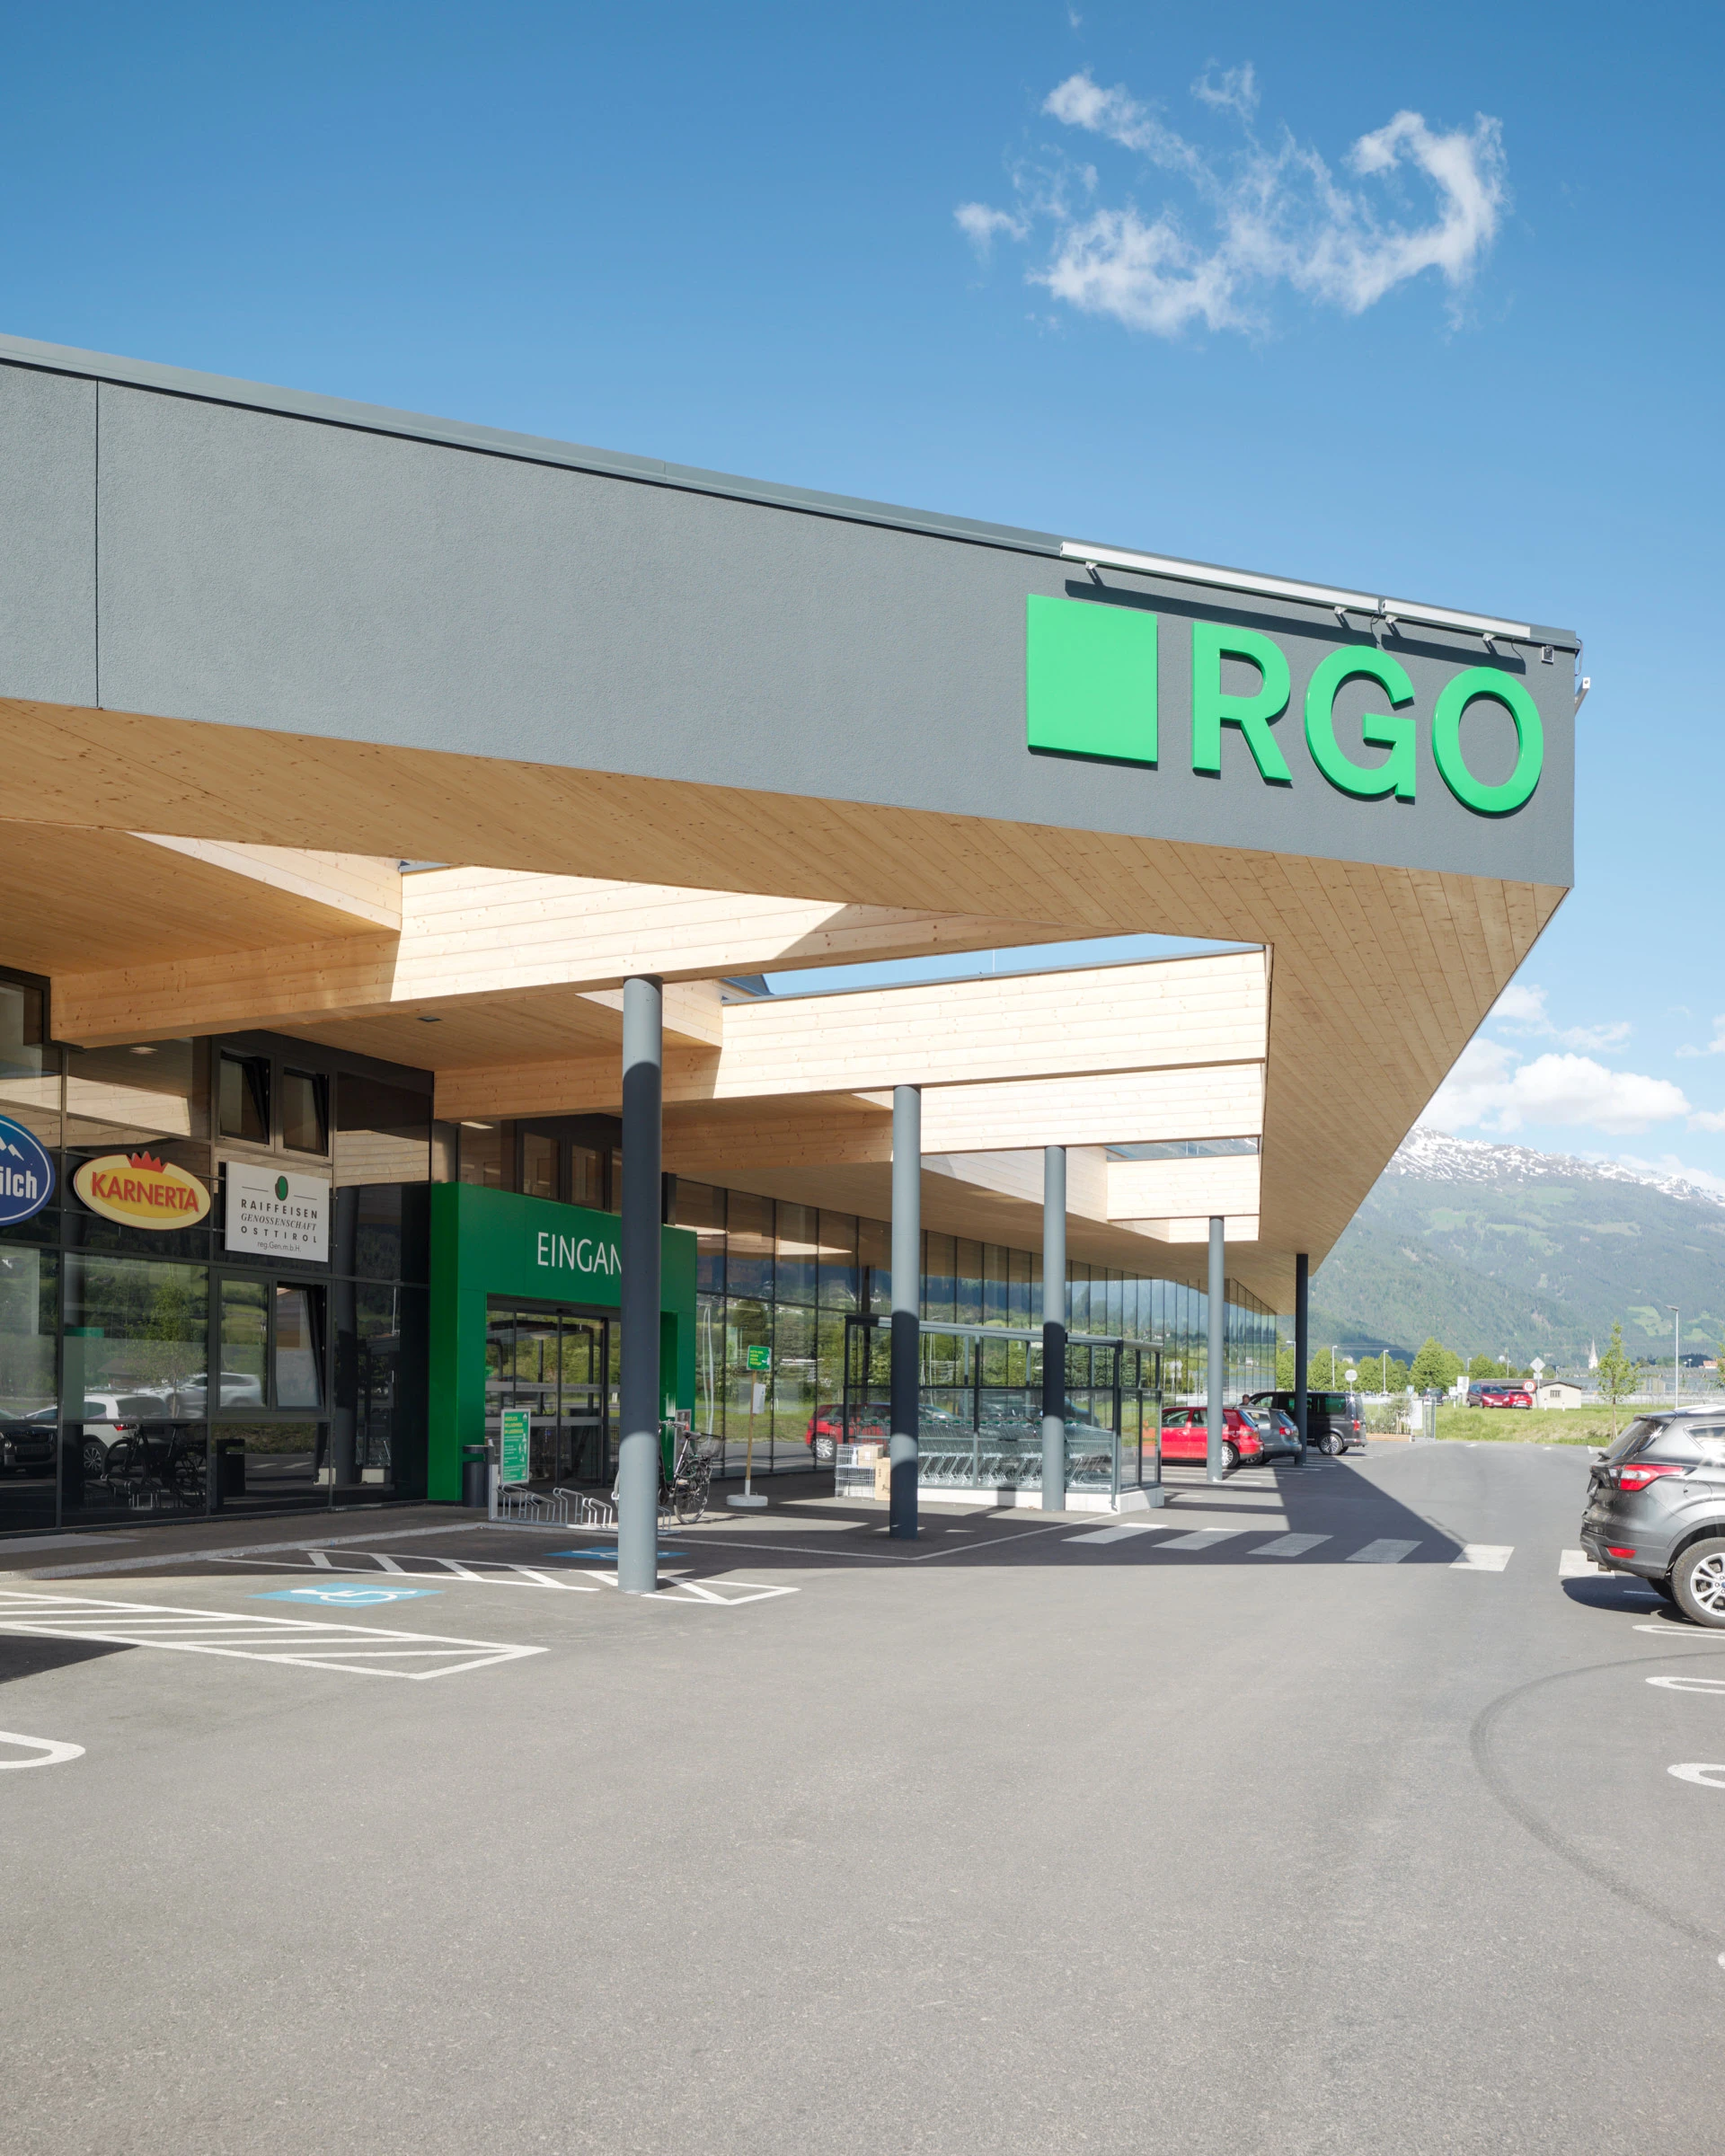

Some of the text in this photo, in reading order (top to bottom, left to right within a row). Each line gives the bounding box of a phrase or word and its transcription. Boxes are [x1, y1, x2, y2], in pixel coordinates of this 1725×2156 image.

[1192, 621, 1544, 813] RGO
[92, 1171, 199, 1213] KARNERTA
[241, 1198, 317, 1219] RAIFFEISEN
[241, 1213, 317, 1231] GENOSSENSCHAFT
[241, 1225, 317, 1243] OSTTIROL
